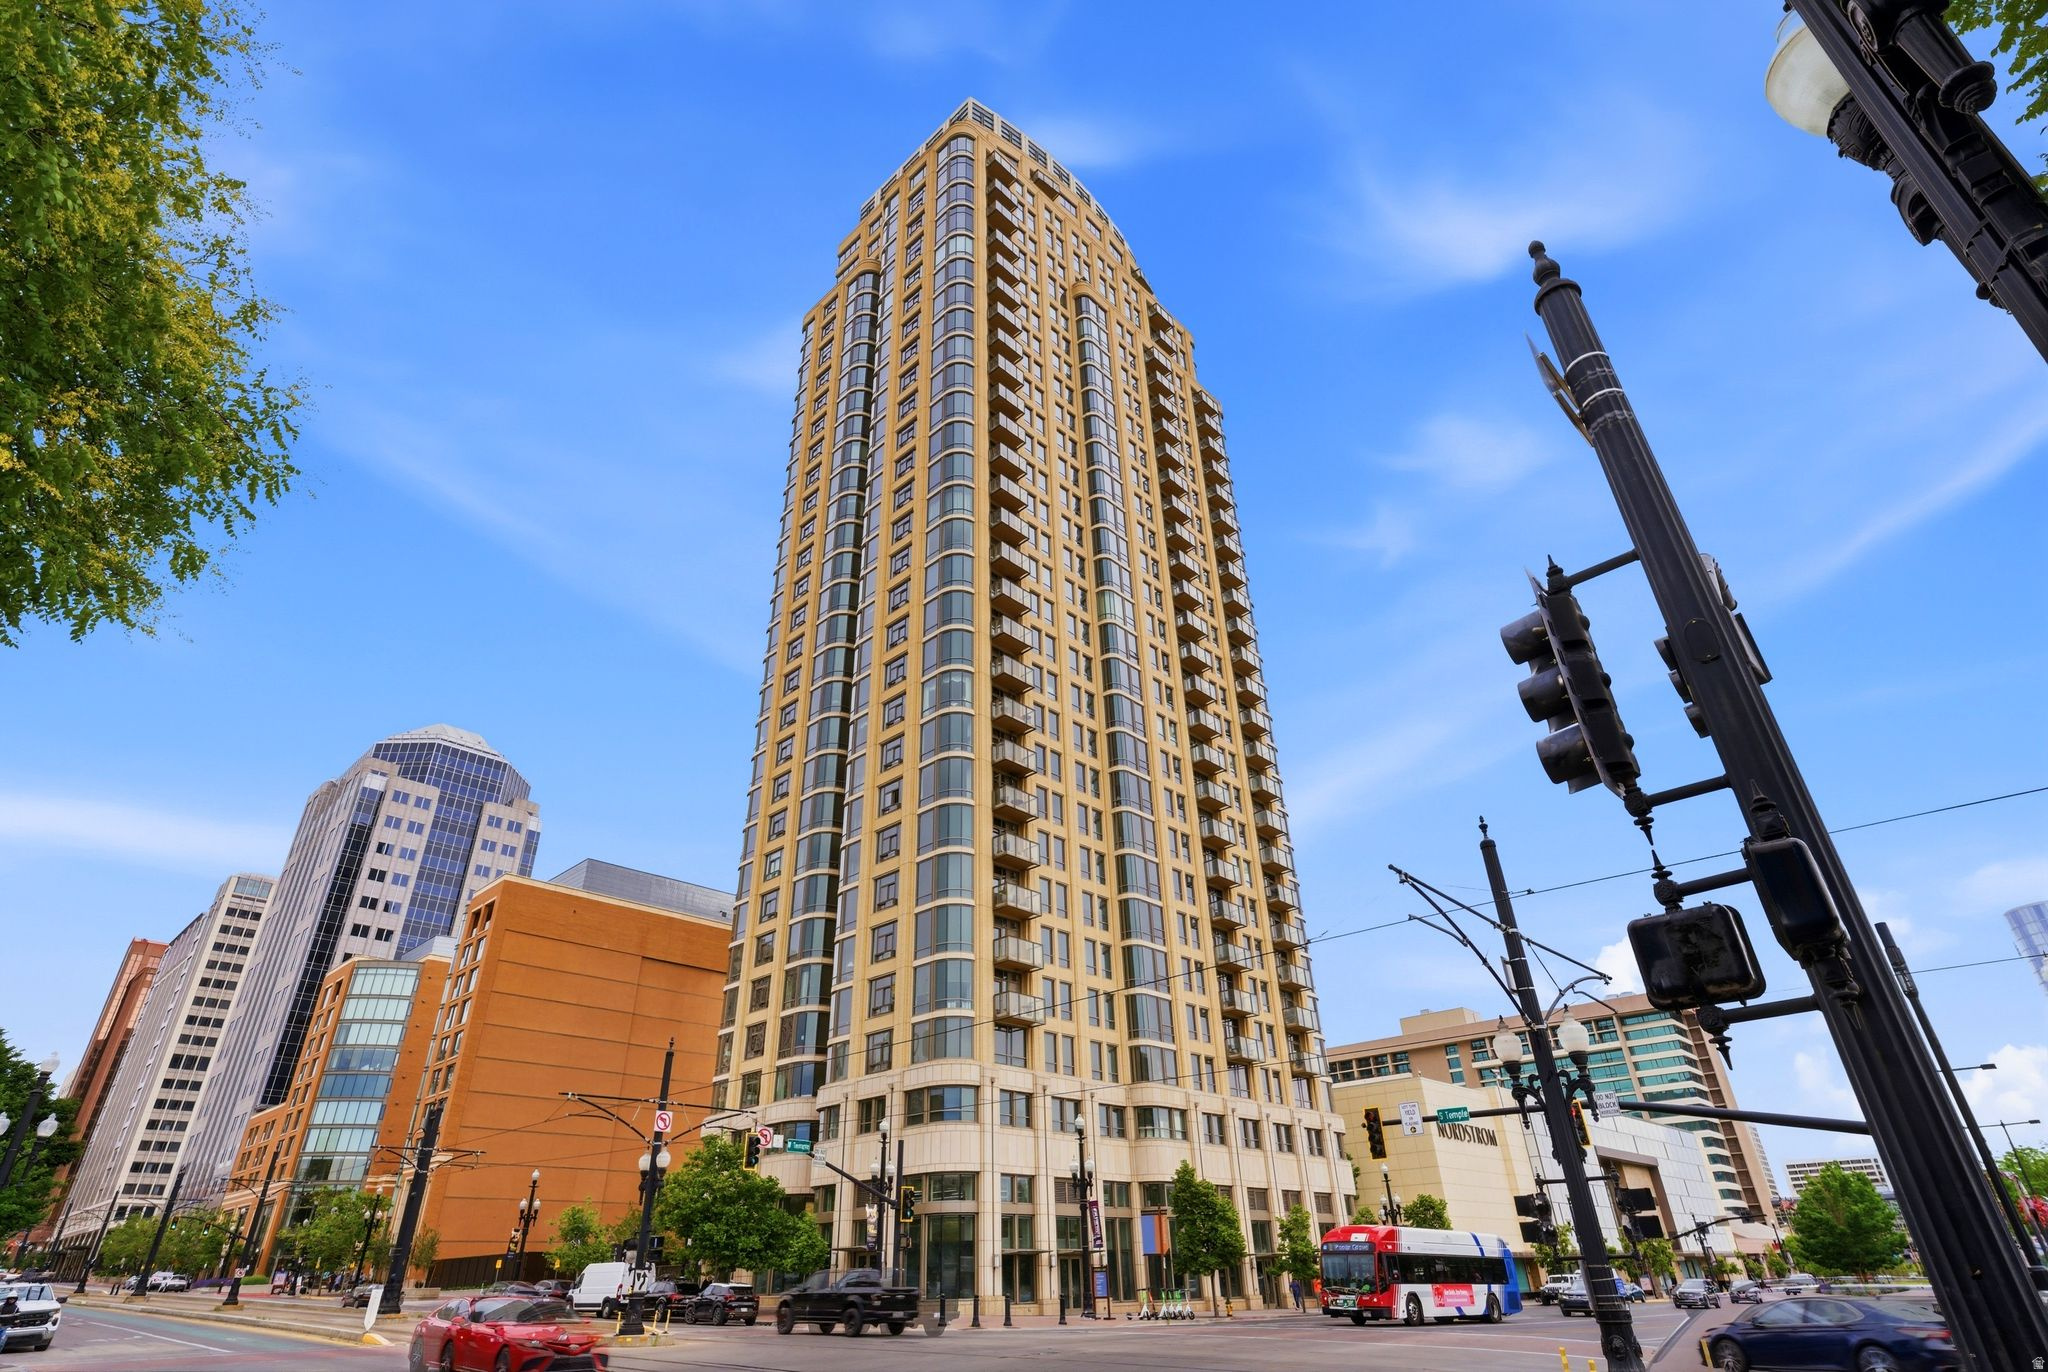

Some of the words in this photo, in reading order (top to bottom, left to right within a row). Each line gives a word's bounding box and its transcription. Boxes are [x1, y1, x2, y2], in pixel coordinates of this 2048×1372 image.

[1438, 1112, 1443, 1120] S
[1446, 1109, 1468, 1120] Temple
[1436, 1122, 1498, 1146] NORDSTROM
